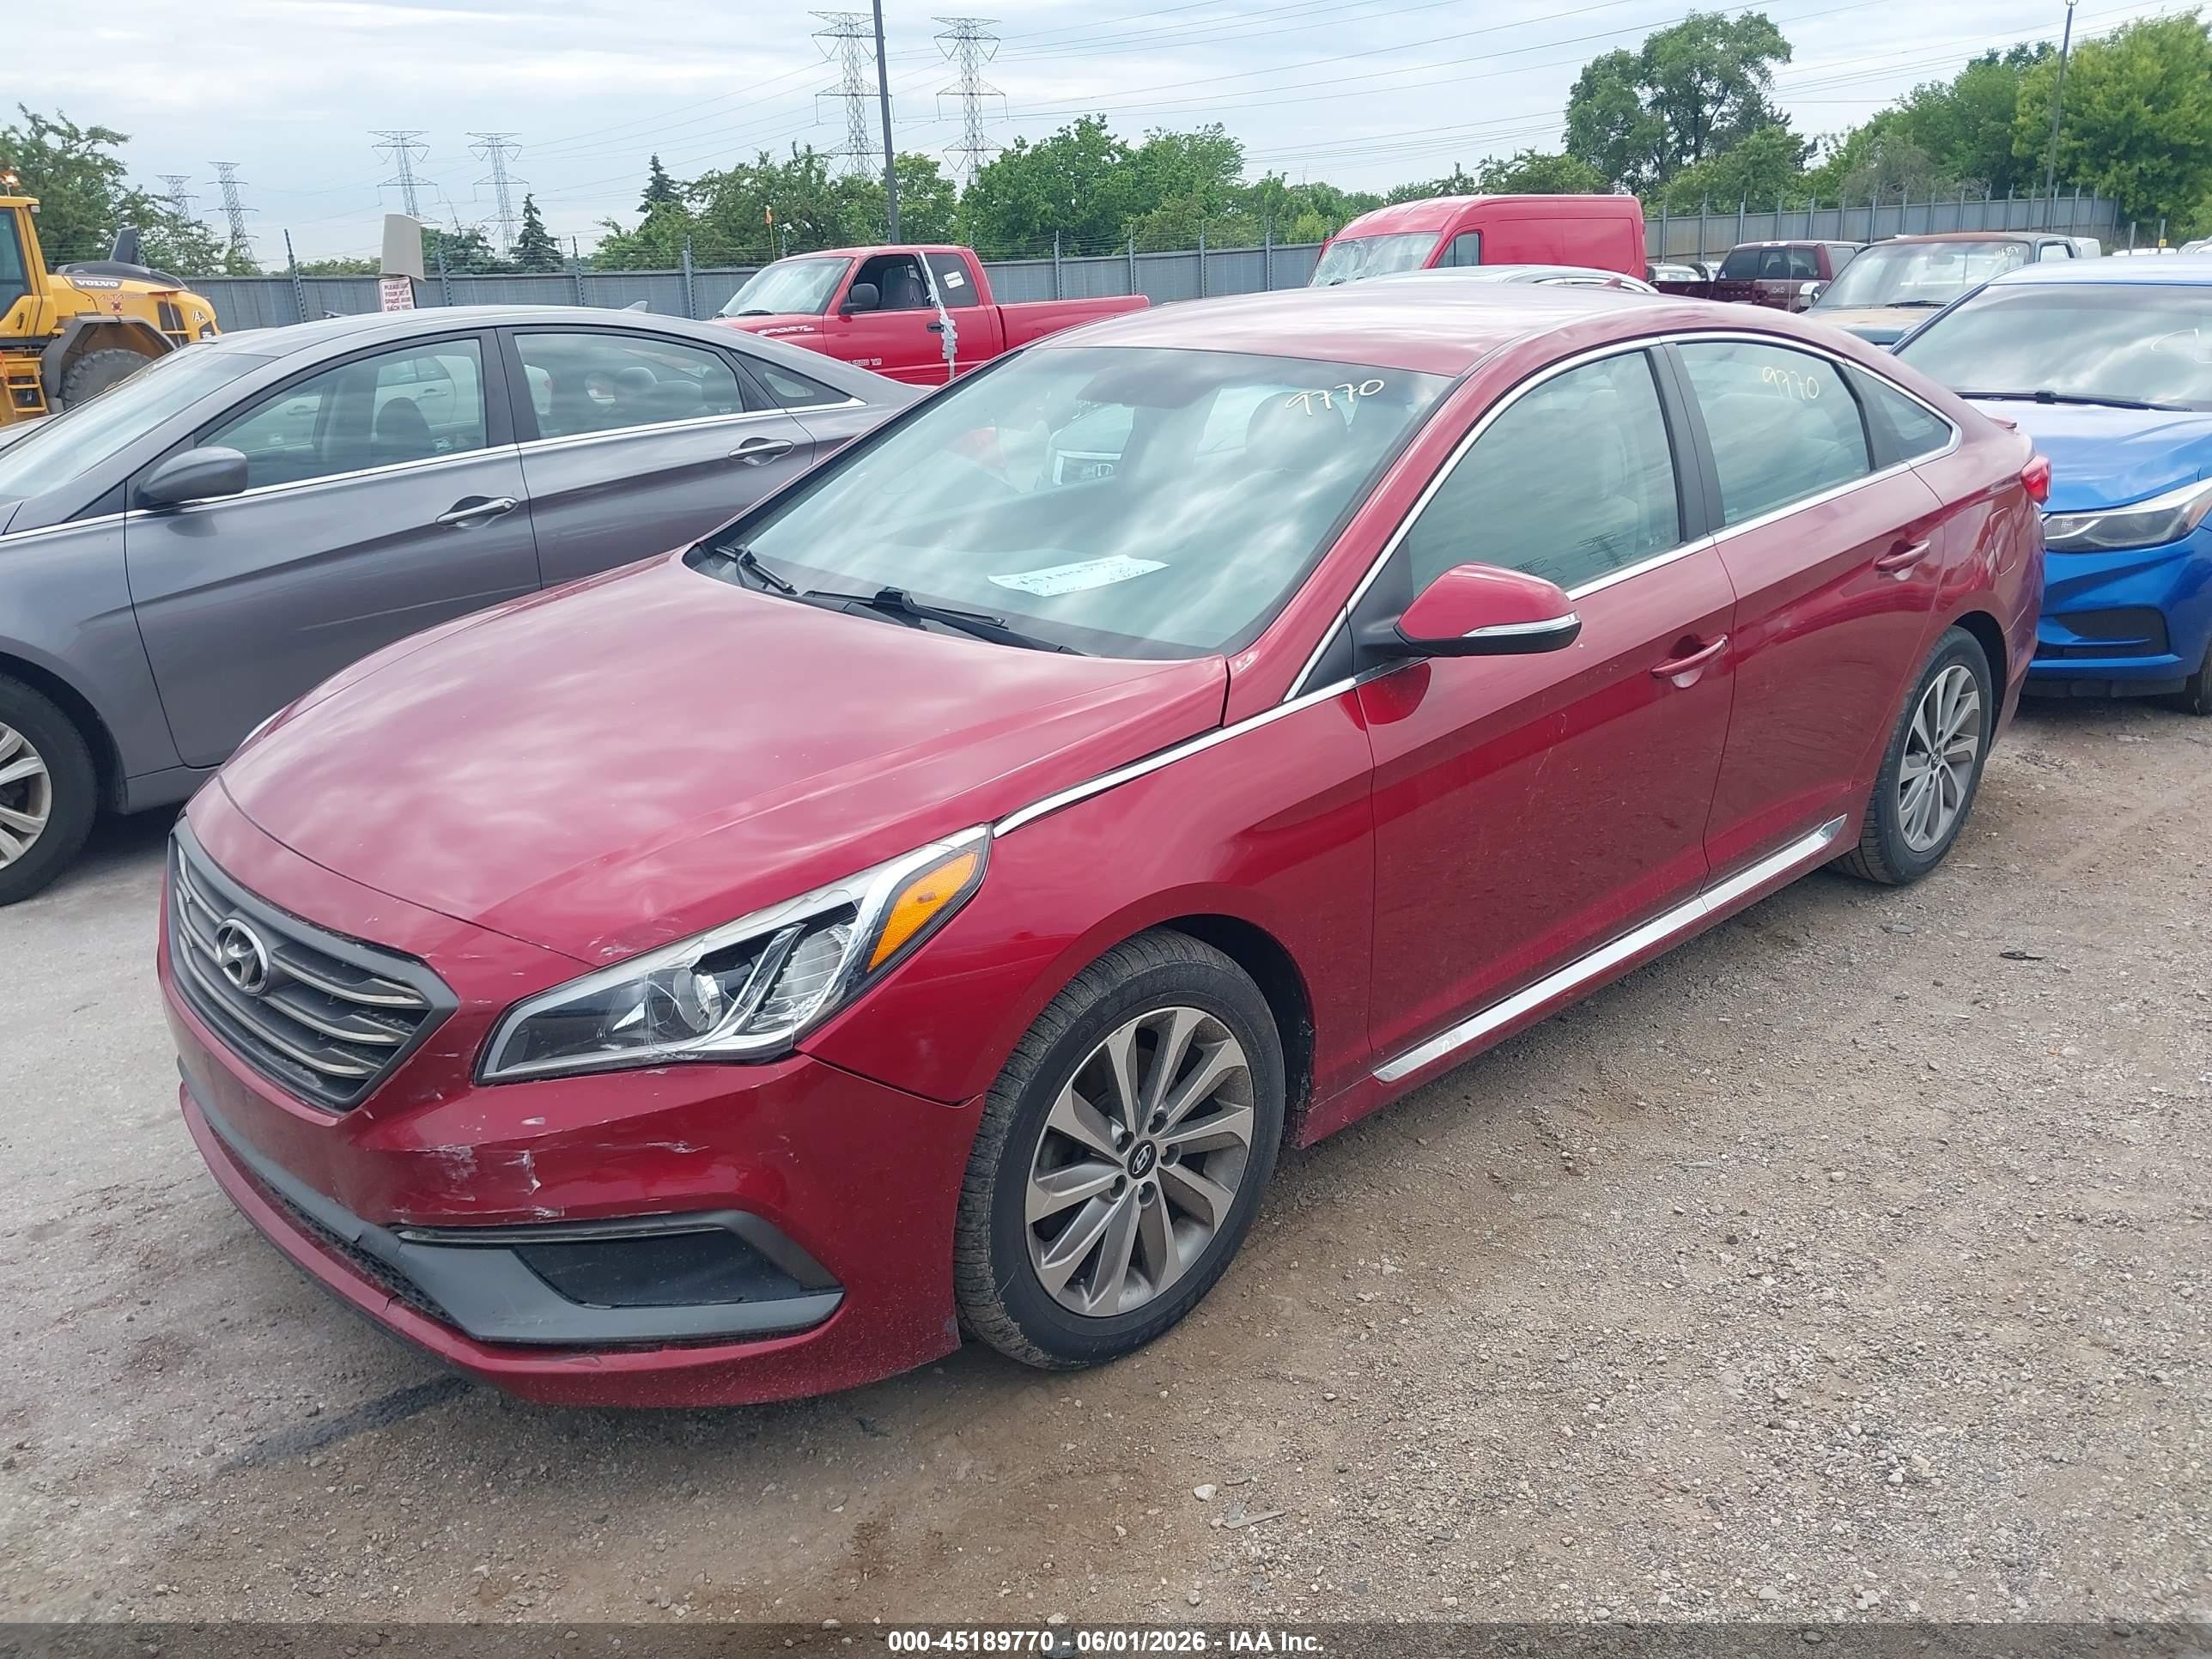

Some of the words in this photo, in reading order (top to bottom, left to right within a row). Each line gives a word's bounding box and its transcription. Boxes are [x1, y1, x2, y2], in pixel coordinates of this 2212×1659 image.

[76, 279, 118, 288] VOLVO
[757, 325, 808, 336] SPORT
[1762, 366, 1820, 399] 9770
[1285, 379, 1385, 416] 9770
